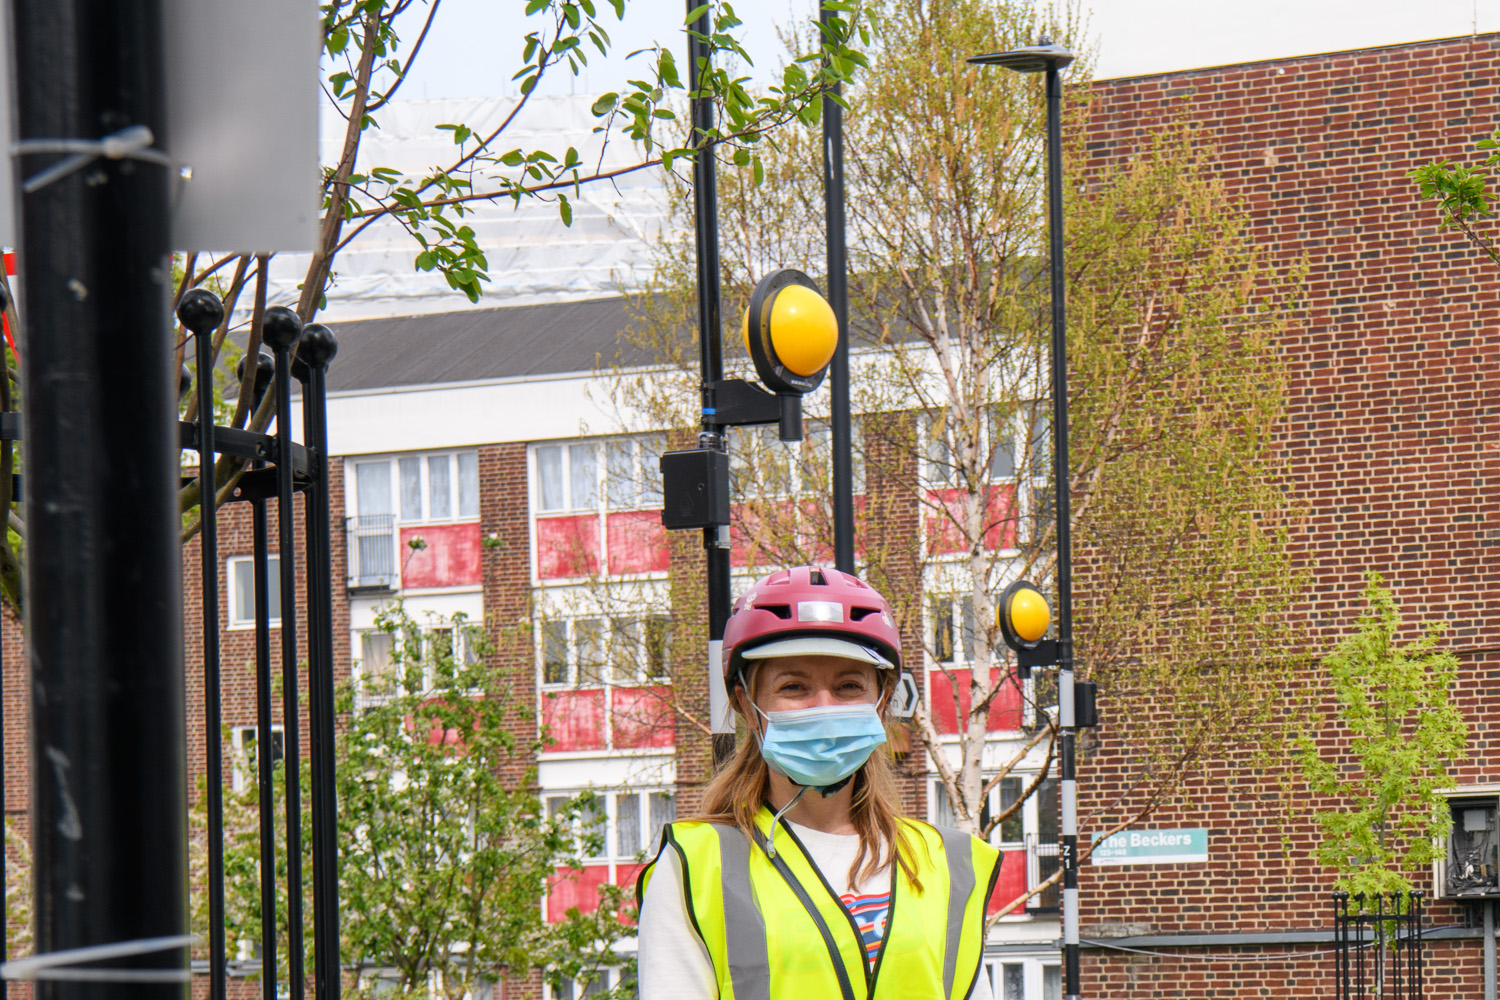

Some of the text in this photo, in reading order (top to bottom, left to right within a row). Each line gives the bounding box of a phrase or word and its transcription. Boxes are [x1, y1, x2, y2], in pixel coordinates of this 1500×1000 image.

[1130, 832, 1192, 848] Beckers
[1063, 845, 1071, 856] Z
[1064, 858, 1071, 869] 1
